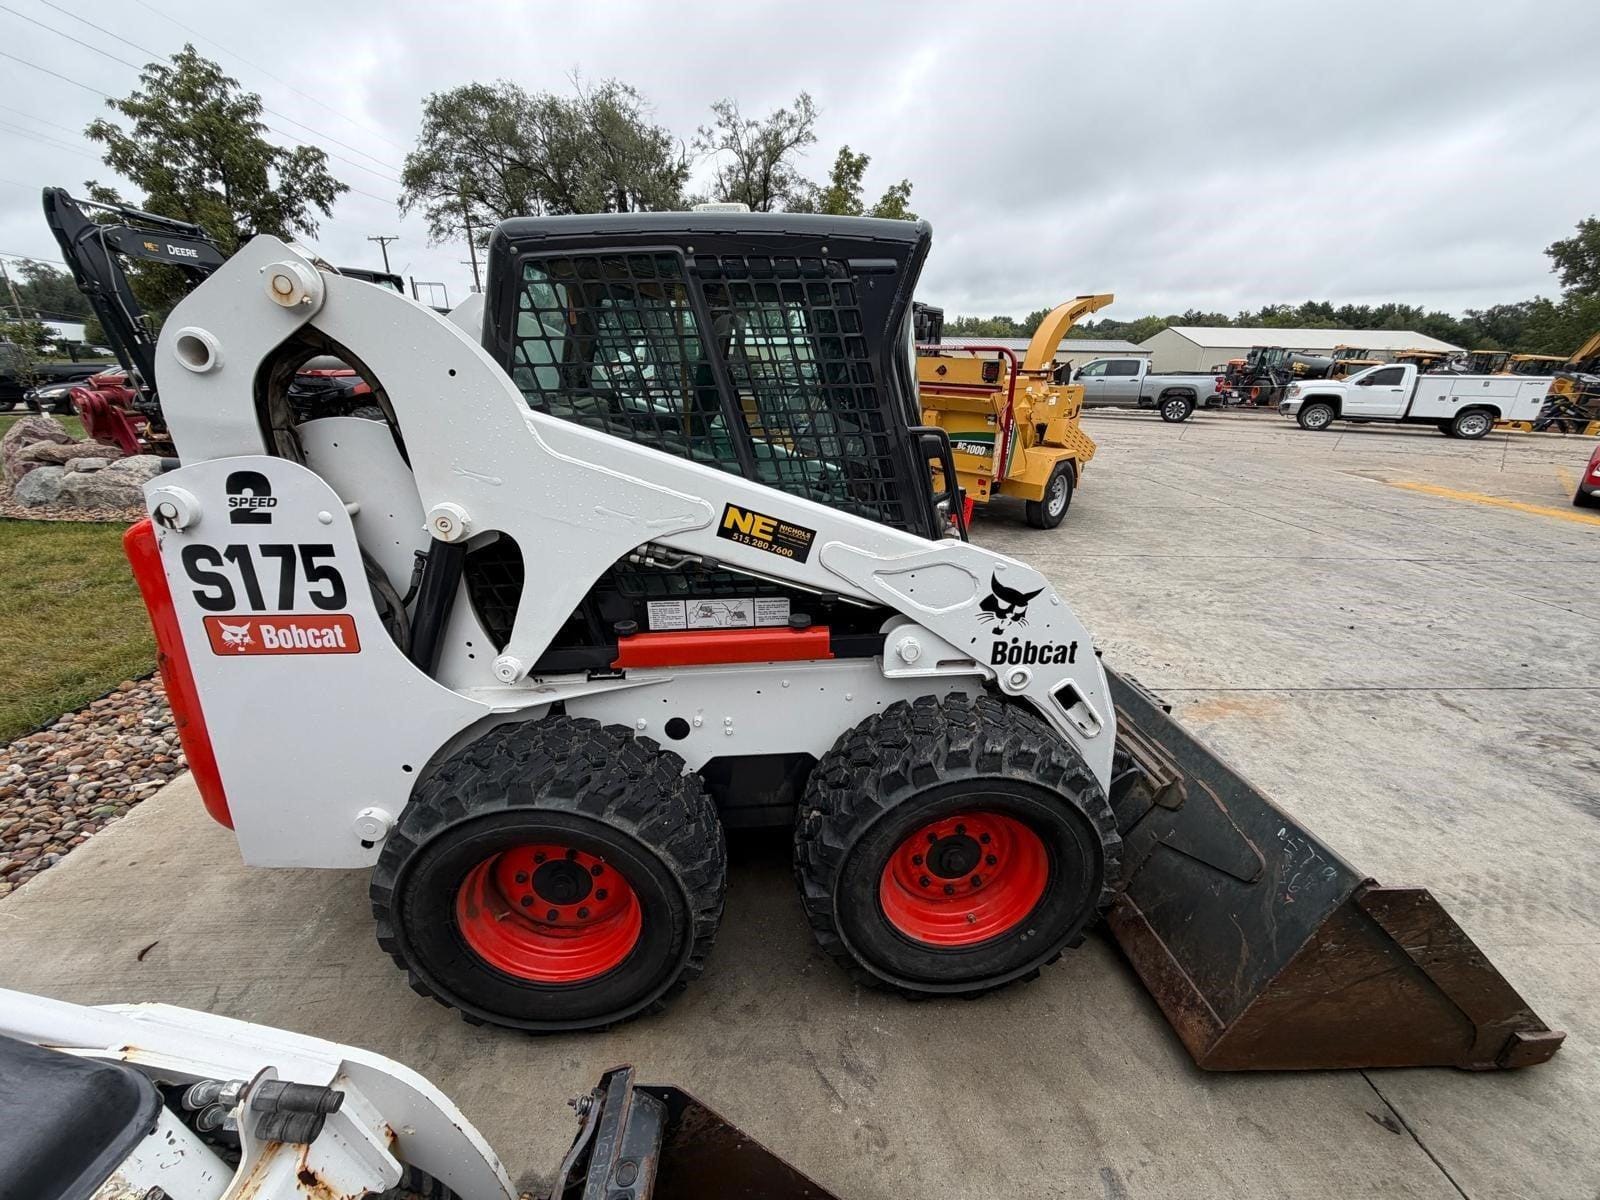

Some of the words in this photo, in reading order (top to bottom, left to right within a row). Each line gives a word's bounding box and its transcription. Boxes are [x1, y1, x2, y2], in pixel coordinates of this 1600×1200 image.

[166, 244, 199, 258] DEERE
[225, 470, 272, 524] 2
[228, 497, 278, 508] SPEED
[723, 506, 778, 542] NE
[779, 524, 811, 539] NICHOLS
[732, 532, 794, 557] 515.280.7600
[181, 543, 348, 612] S175
[259, 624, 347, 649] Bobcat
[991, 640, 1078, 666] Bobcat
